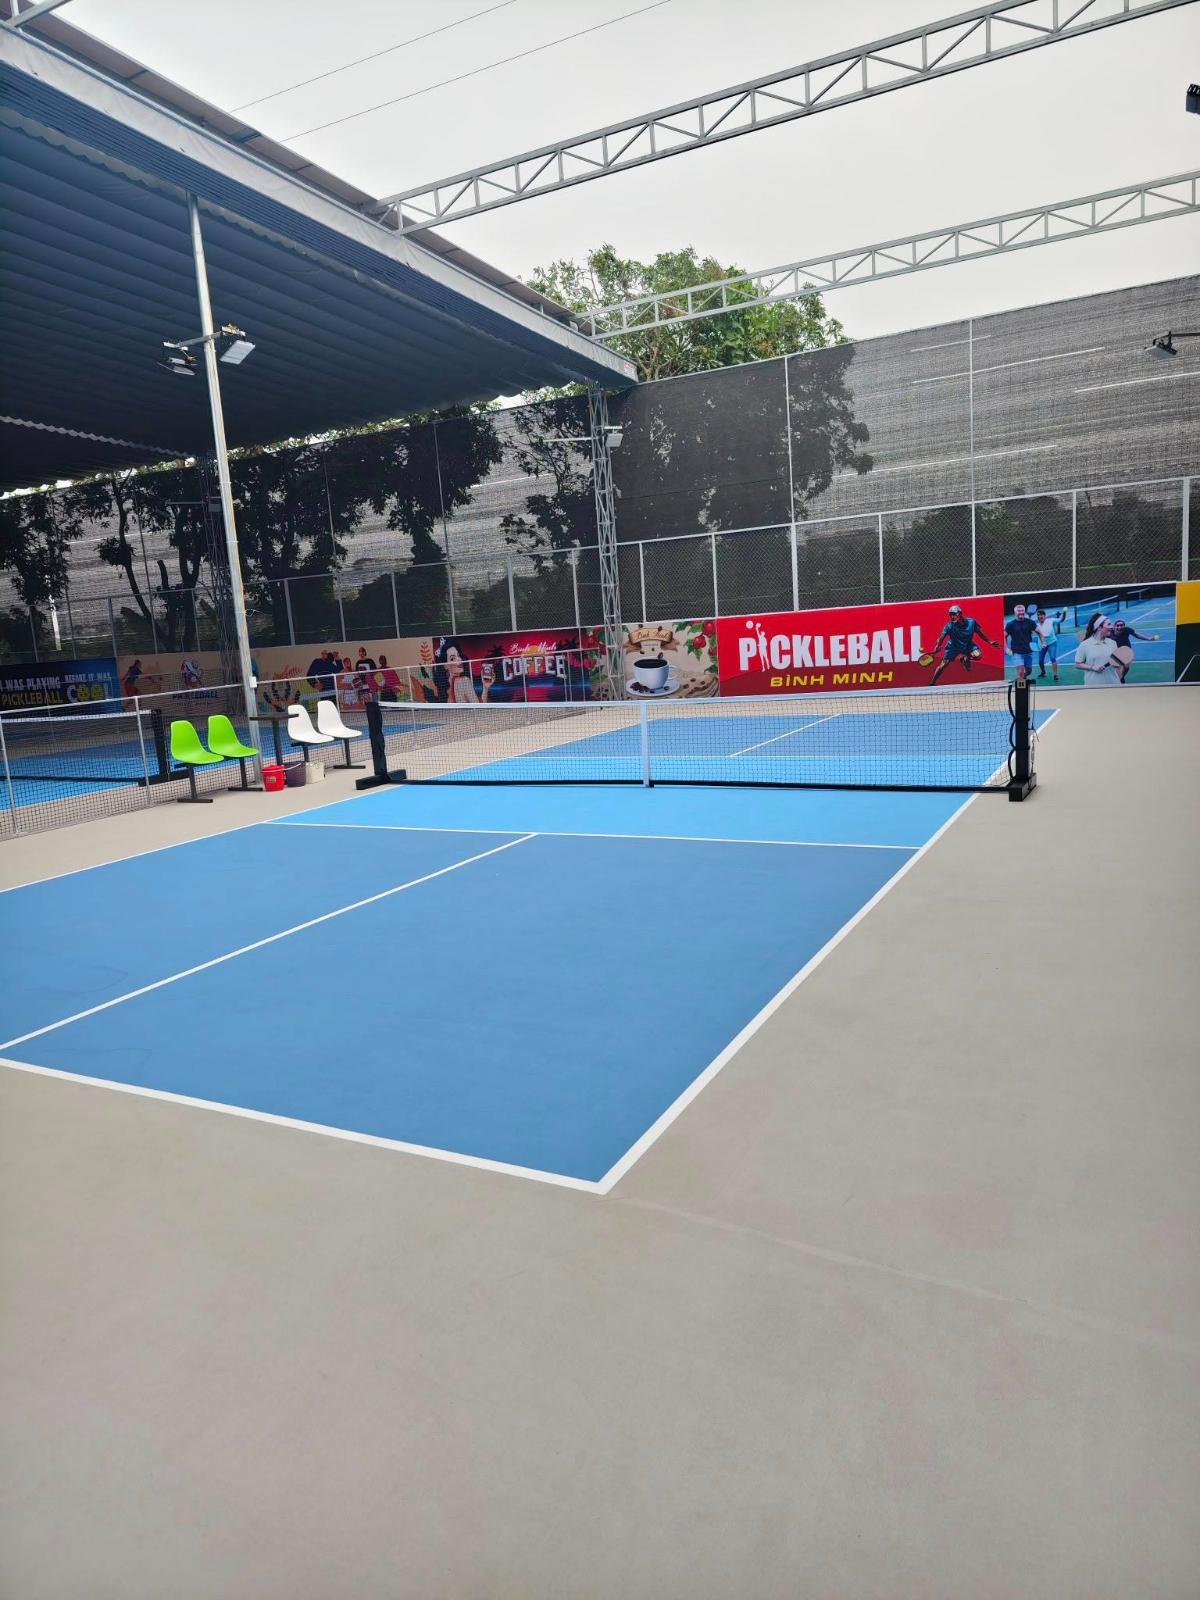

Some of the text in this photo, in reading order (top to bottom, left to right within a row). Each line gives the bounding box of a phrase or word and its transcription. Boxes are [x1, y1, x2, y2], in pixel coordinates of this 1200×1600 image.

[738, 624, 925, 671] PICKLEBALL
[502, 654, 568, 681] COFFEE
[5, 678, 25, 691] WAS
[26, 675, 61, 690] PLAYING
[832, 671, 894, 685] MINH
[1, 691, 64, 705] PICKLEBALL
